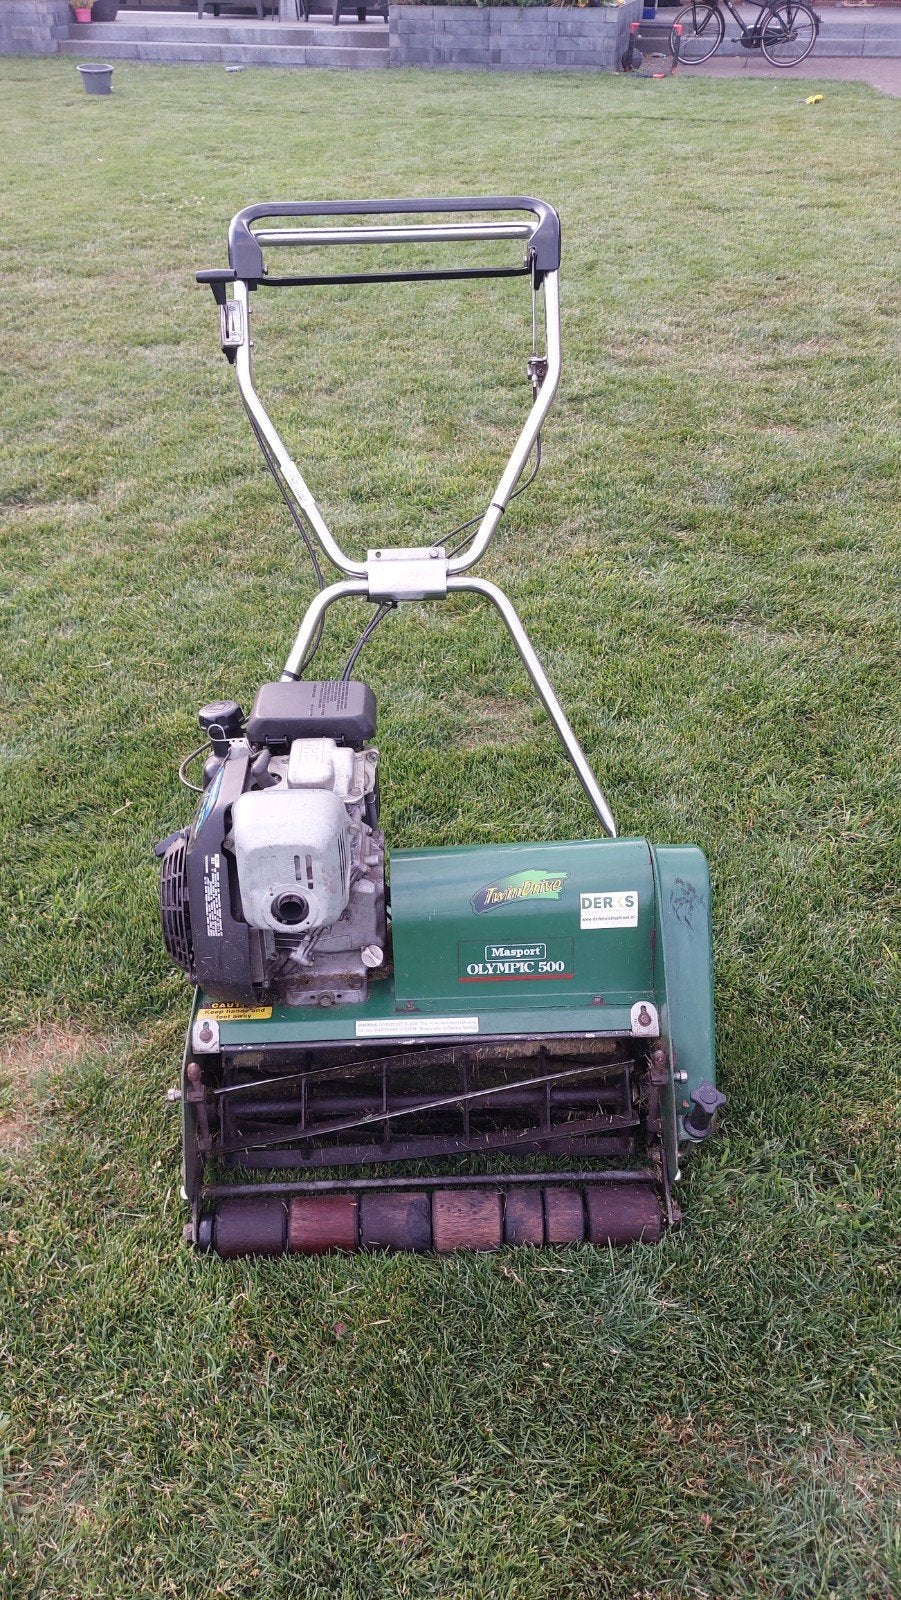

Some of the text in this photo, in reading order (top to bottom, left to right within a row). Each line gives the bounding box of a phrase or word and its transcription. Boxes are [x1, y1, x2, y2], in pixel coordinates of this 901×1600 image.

[484, 878, 562, 905] TwinDrive
[491, 946, 540, 958] Masport
[466, 960, 566, 975] OLYMPIC 500
